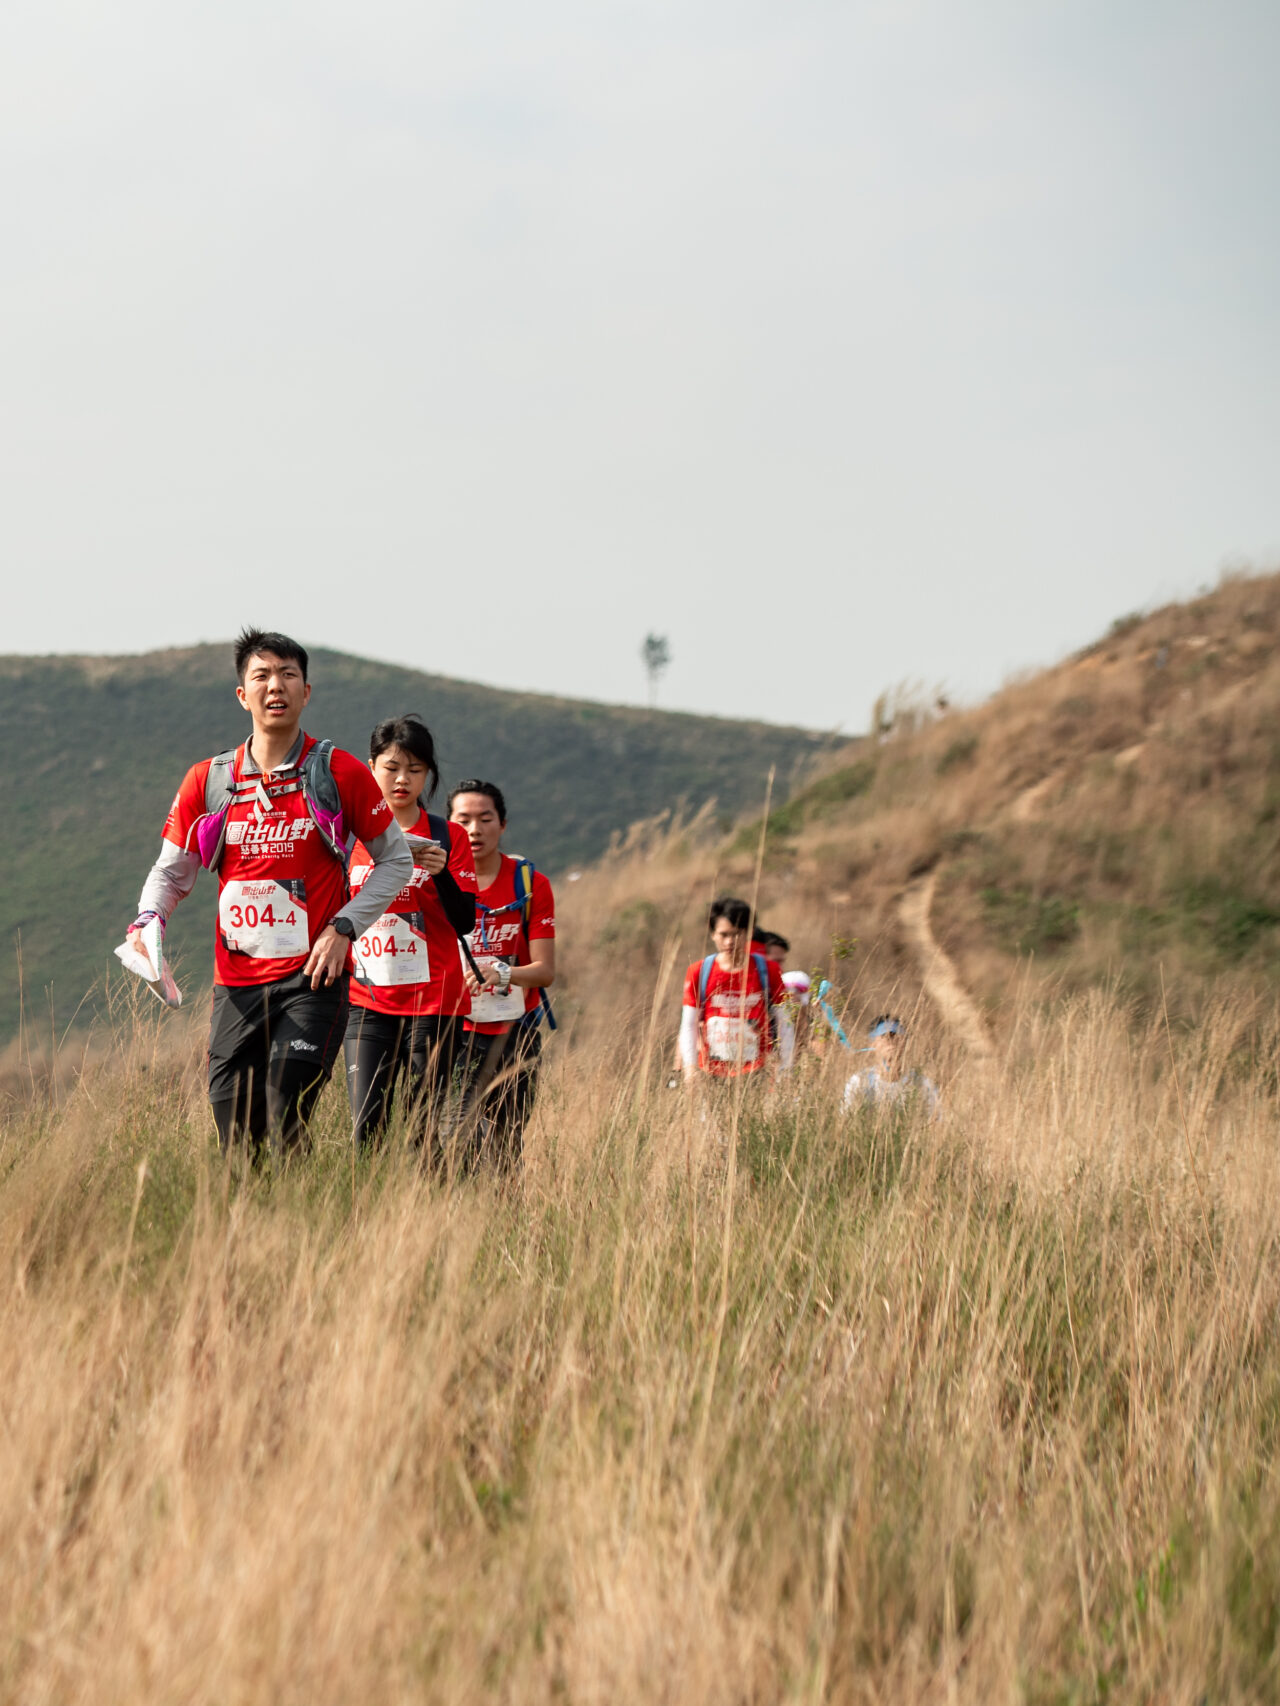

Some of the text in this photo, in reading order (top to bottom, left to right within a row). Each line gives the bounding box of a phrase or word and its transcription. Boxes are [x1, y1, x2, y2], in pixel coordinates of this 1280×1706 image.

[225, 818, 316, 845] 圖出山野
[229, 904, 297, 928] 304-4
[360, 935, 417, 957] 304-4
